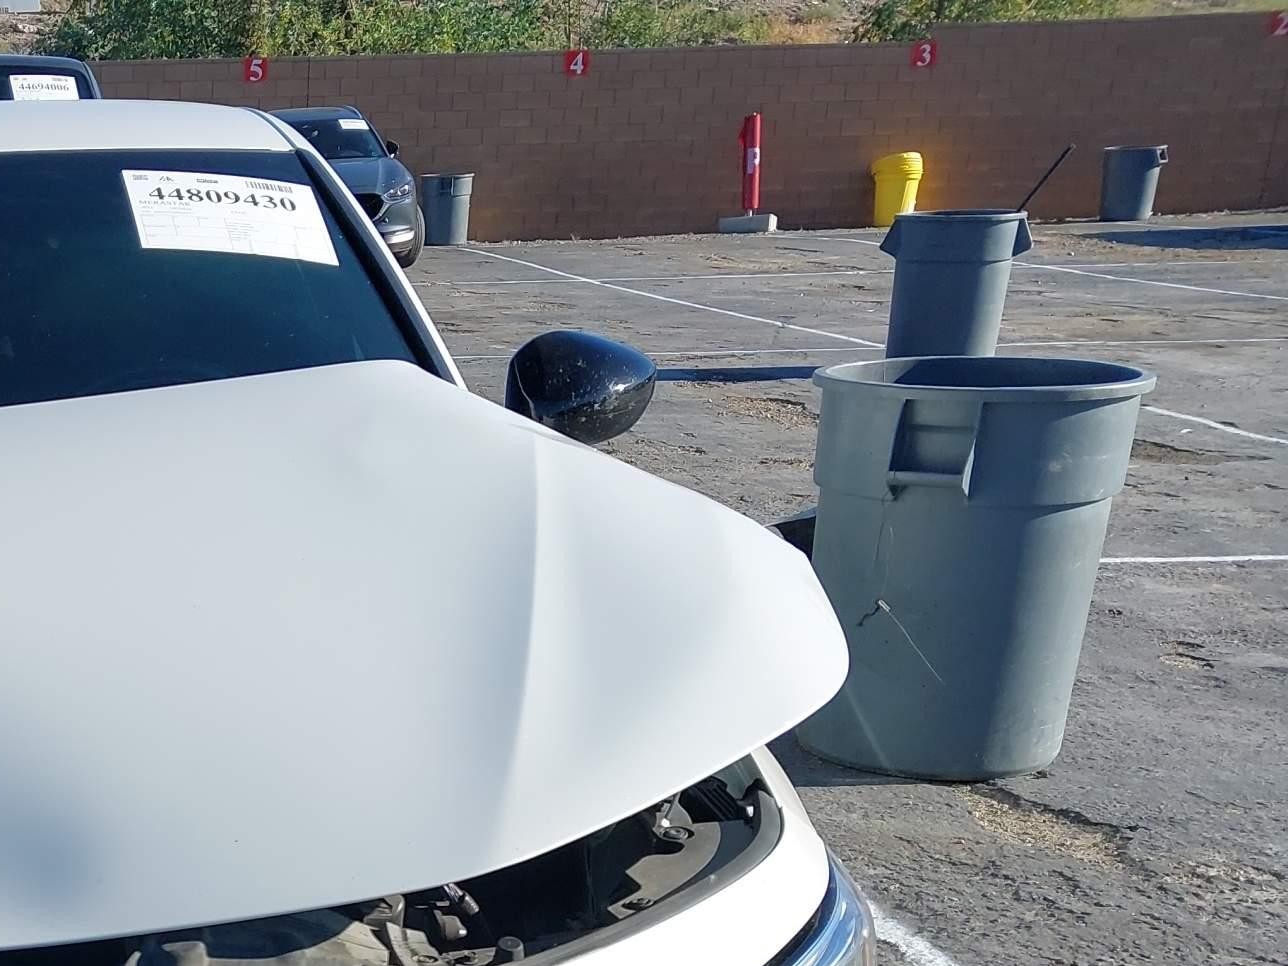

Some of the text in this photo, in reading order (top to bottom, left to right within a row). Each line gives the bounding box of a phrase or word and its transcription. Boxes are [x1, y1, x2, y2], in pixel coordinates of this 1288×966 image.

[570, 52, 584, 74] 4
[916, 44, 931, 67] 3
[249, 59, 263, 81] 5
[148, 186, 297, 212] 44809430
